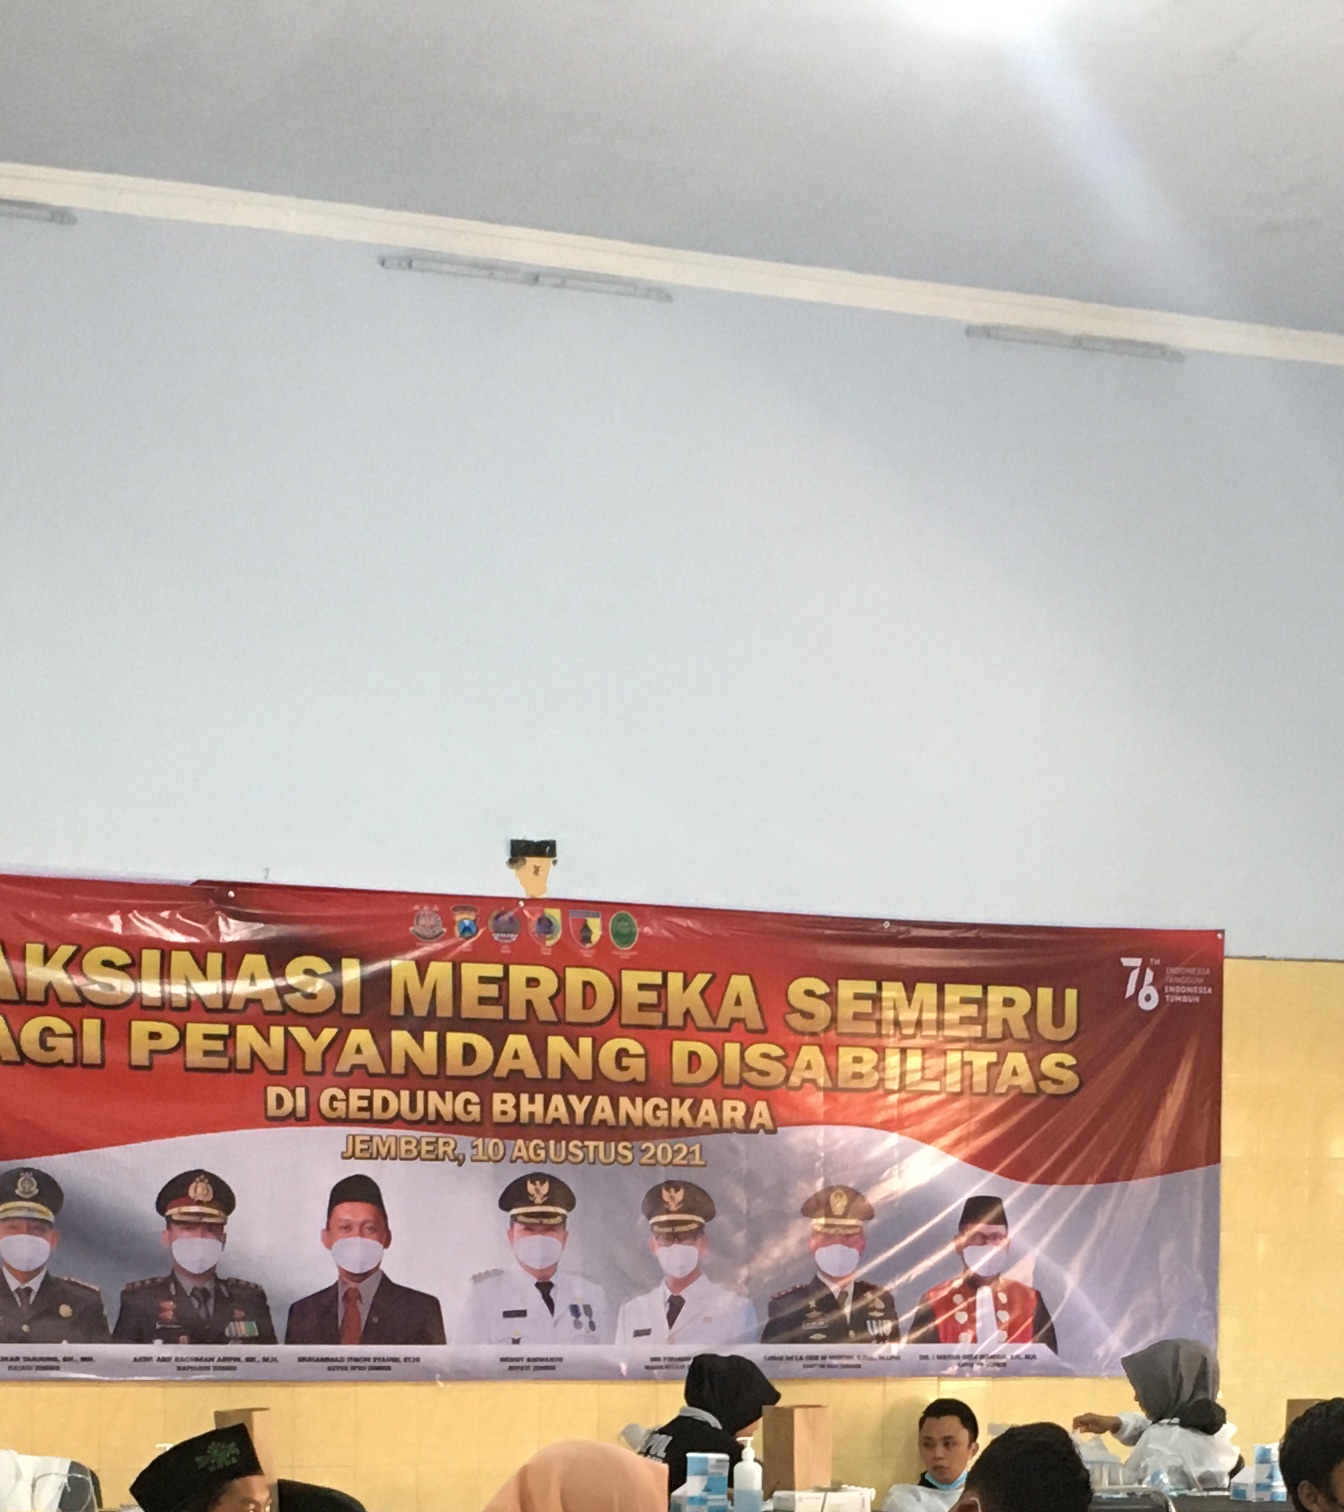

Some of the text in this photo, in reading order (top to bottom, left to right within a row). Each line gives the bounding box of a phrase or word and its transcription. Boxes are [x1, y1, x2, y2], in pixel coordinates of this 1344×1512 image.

[389, 958, 766, 1033] MERDEKA
[784, 976, 1080, 1042] SEMERU
[1164, 985, 1213, 995] INDONESIA
[127, 1017, 649, 1084] PENYANDANG
[669, 1039, 1082, 1096] DISABILITAS
[265, 1085, 777, 1133] DI GEDUNG BHAYANGKARA
[340, 1134, 707, 1167] JEMBER, 10 AGUSTUS 2021
